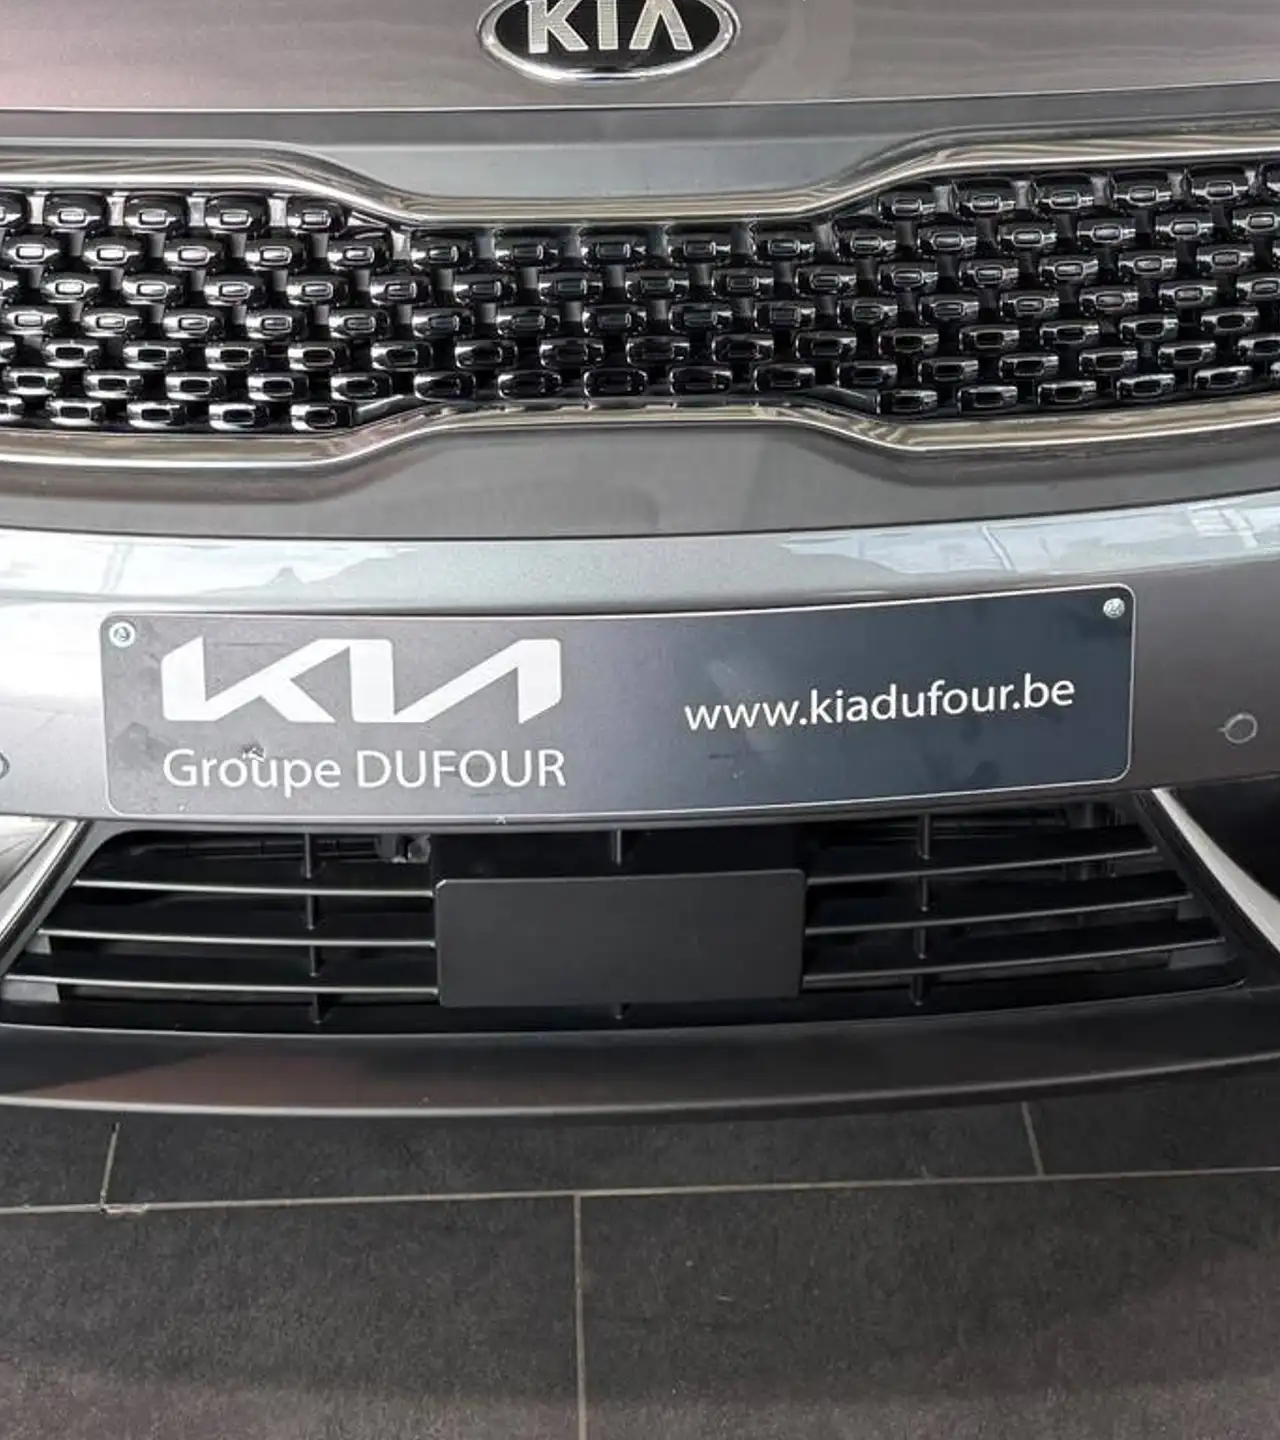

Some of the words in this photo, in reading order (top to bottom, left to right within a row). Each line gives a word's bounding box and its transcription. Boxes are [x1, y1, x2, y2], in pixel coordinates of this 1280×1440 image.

[160, 636, 563, 725] KIA
[684, 672, 1076, 731] www.kiadufour.be
[162, 748, 342, 799] Groupe
[356, 748, 568, 789] DUFOUR
